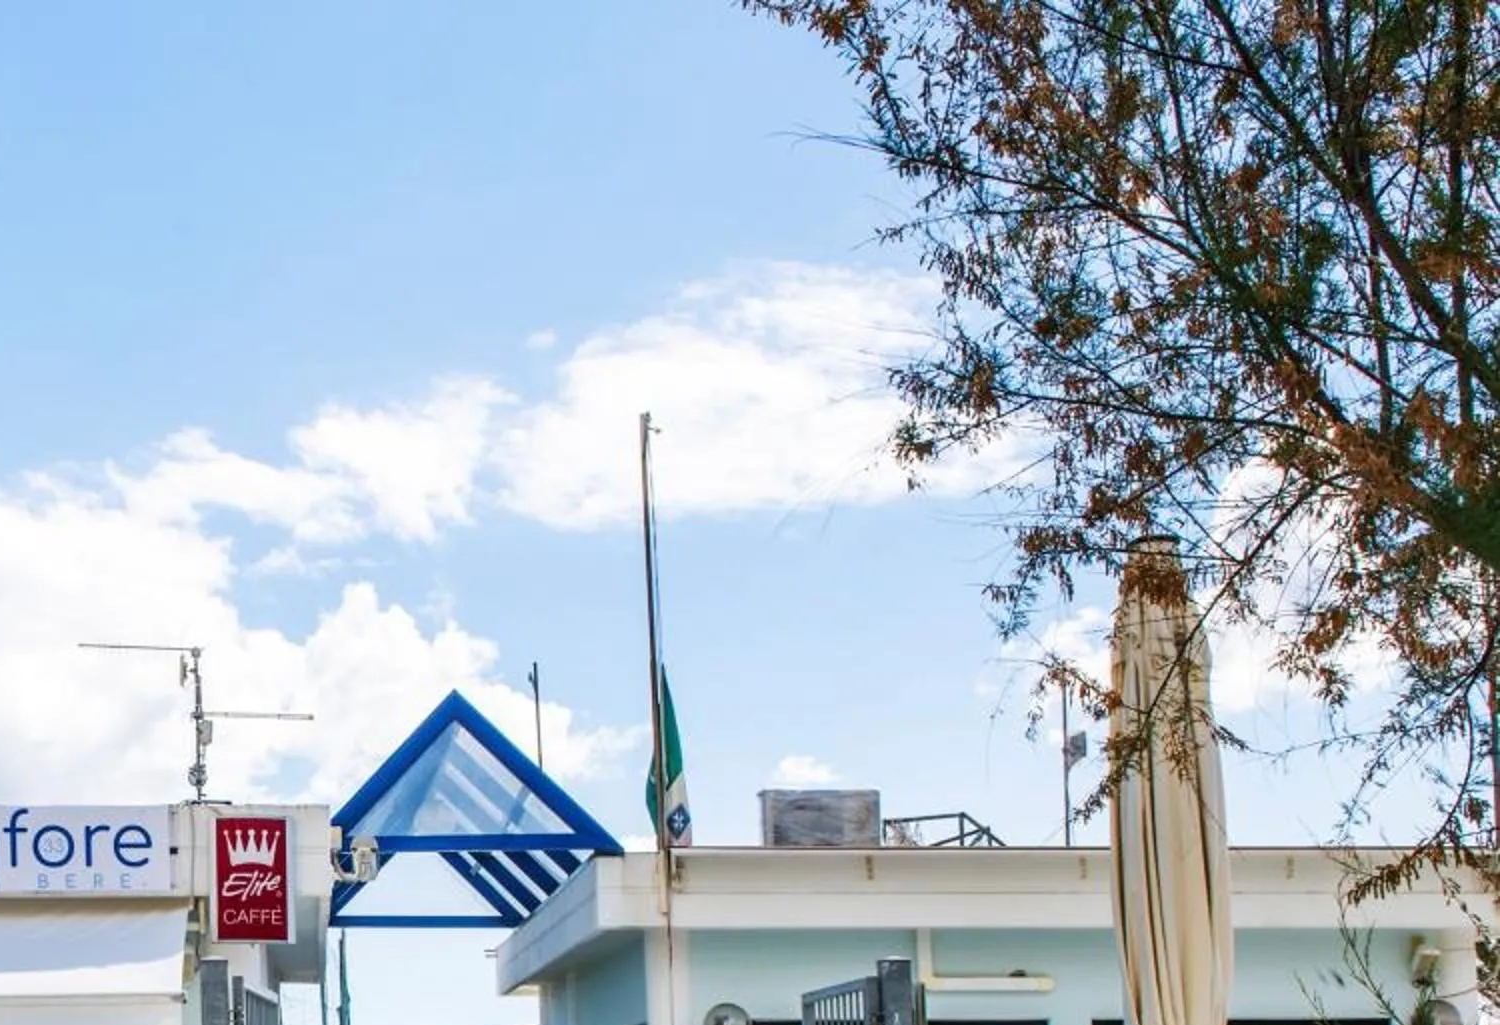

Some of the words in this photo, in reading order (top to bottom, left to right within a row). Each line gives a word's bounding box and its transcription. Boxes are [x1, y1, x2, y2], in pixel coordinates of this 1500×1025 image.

[37, 873, 132, 890] BERE
[222, 870, 281, 901] Elite
[223, 904, 284, 925] CAFFÈ
